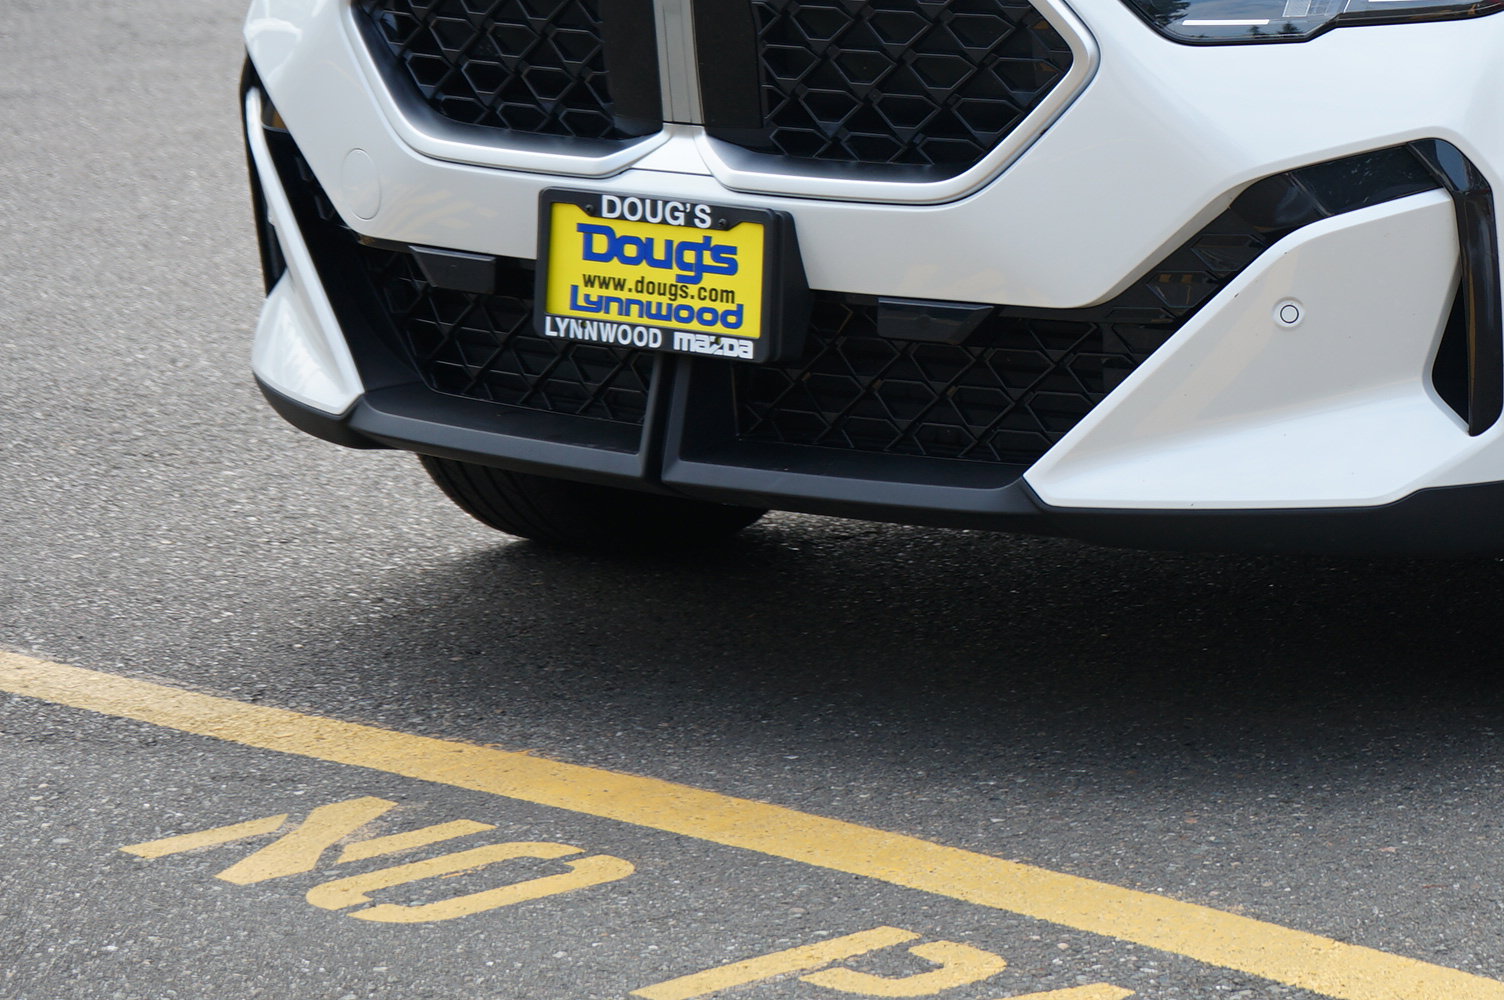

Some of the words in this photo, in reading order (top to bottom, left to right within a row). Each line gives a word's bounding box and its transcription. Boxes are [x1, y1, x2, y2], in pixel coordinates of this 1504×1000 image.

[601, 194, 712, 229] DOUG'S
[576, 222, 739, 285] Doug's
[569, 284, 744, 330] Lynnwood
[582, 273, 736, 304] www.dougs.com
[545, 316, 662, 349] LYNNWOOD
[119, 795, 636, 923] NO
